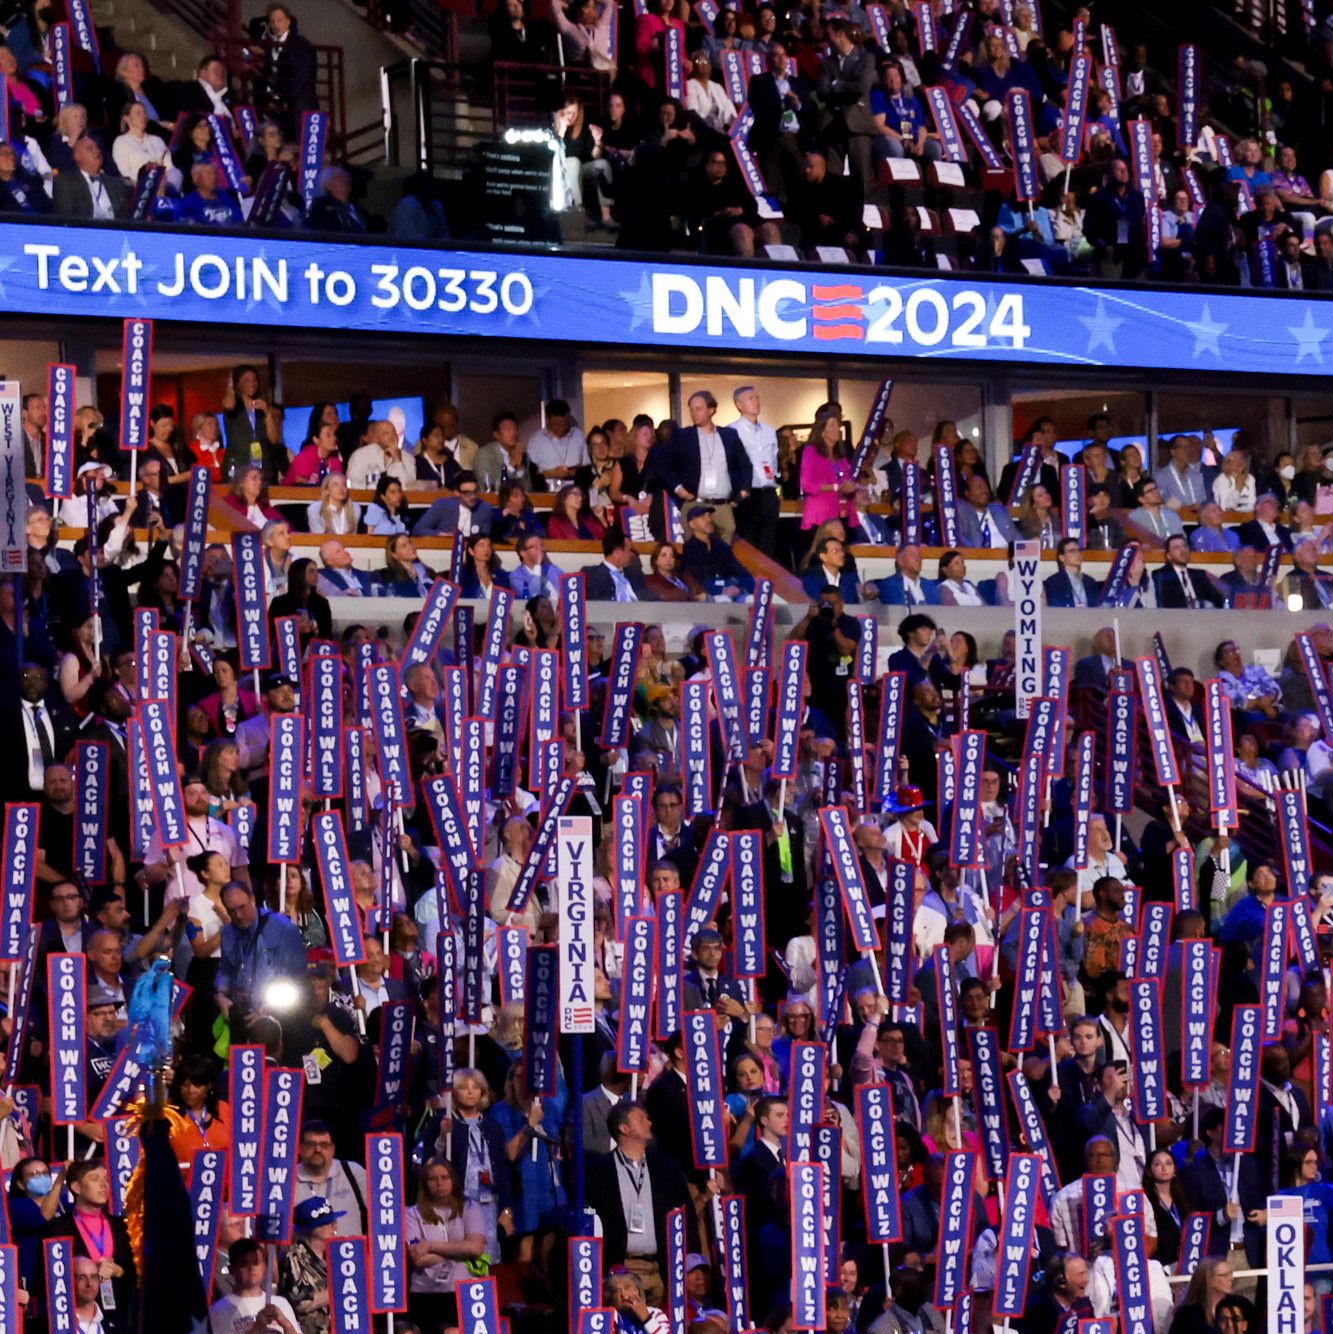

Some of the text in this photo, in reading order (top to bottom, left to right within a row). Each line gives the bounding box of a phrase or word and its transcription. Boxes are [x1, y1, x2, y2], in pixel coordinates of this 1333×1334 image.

[303, 114, 322, 217] COACH WALZ
[23, 244, 533, 316] Text JOIN to 30330
[652, 273, 1029, 349] DNC 2024
[1, 404, 15, 546] WEST VIRGINIA
[53, 368, 67, 491] COACH WALZ
[241, 534, 260, 662] COACH WALZ
[1017, 560, 1036, 693] WYOMING
[8, 807, 30, 954] COACH WALZ
[321, 815, 355, 957] COACH WALZ
[566, 841, 586, 1002] VIRGINIA
[739, 837, 757, 970] COACH WALZ
[59, 959, 79, 1116] COACH WALZ
[564, 1007, 573, 1030] DNC
[377, 1138, 396, 1303] COACH WALZ
[801, 1167, 816, 1321] COACH WALZ
